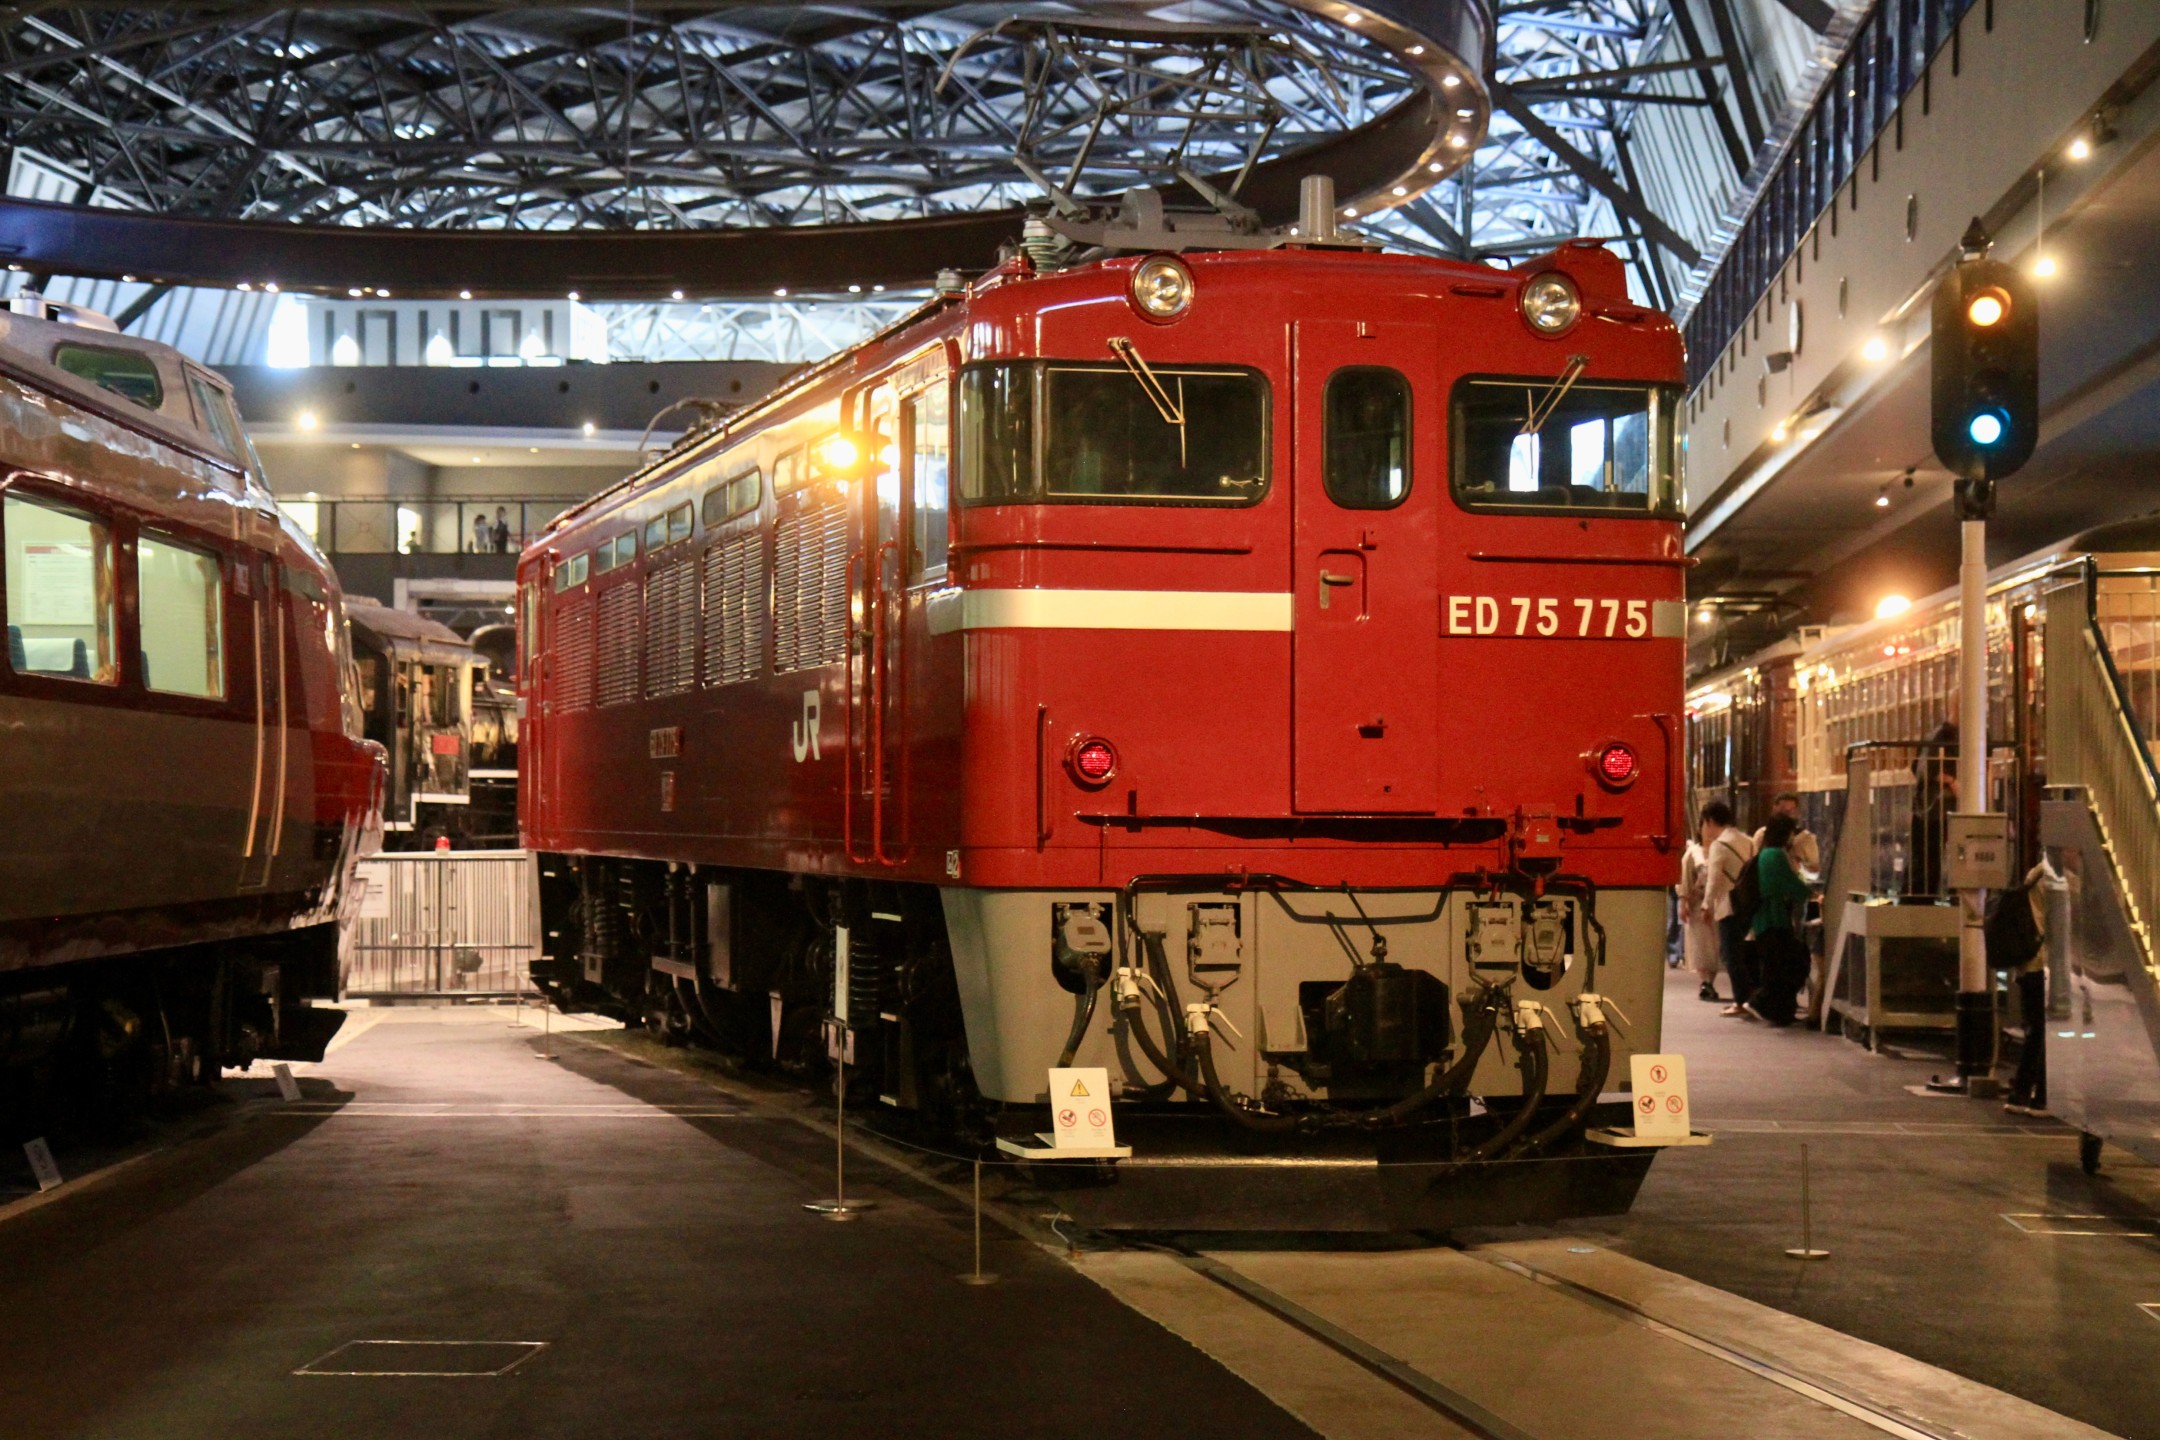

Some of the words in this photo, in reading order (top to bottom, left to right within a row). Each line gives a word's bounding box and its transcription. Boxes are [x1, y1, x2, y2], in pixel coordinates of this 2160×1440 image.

[1449, 596, 1499, 635] ED
[1511, 597, 1559, 636] 75
[1574, 598, 1647, 638] 775
[793, 690, 820, 763] JR
